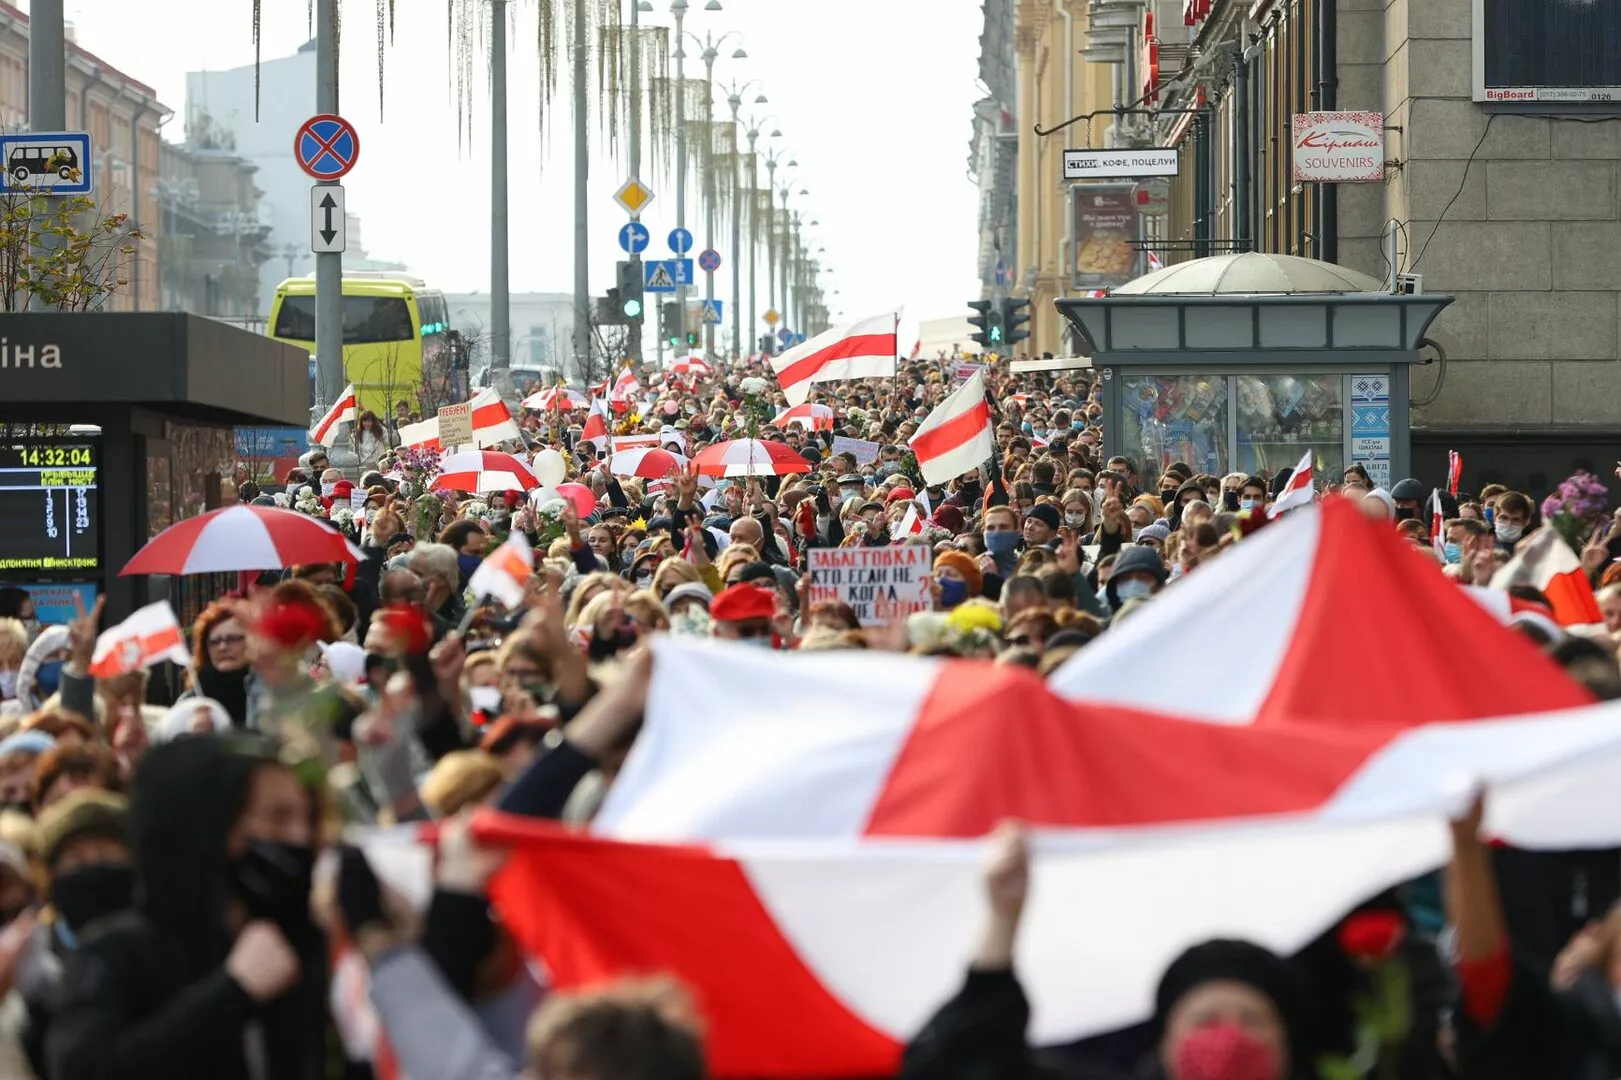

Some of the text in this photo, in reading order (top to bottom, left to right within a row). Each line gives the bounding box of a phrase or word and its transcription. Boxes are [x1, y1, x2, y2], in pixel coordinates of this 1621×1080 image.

[1487, 91, 1534, 100] BigBoard
[1297, 131, 1378, 153] Кірмаш
[1103, 159, 1130, 167] КОФЕ,
[1305, 157, 1374, 168] SOUVENIRS
[2, 336, 62, 368] іна
[20, 448, 91, 466] 14:32:04
[893, 566, 914, 583] НЕ
